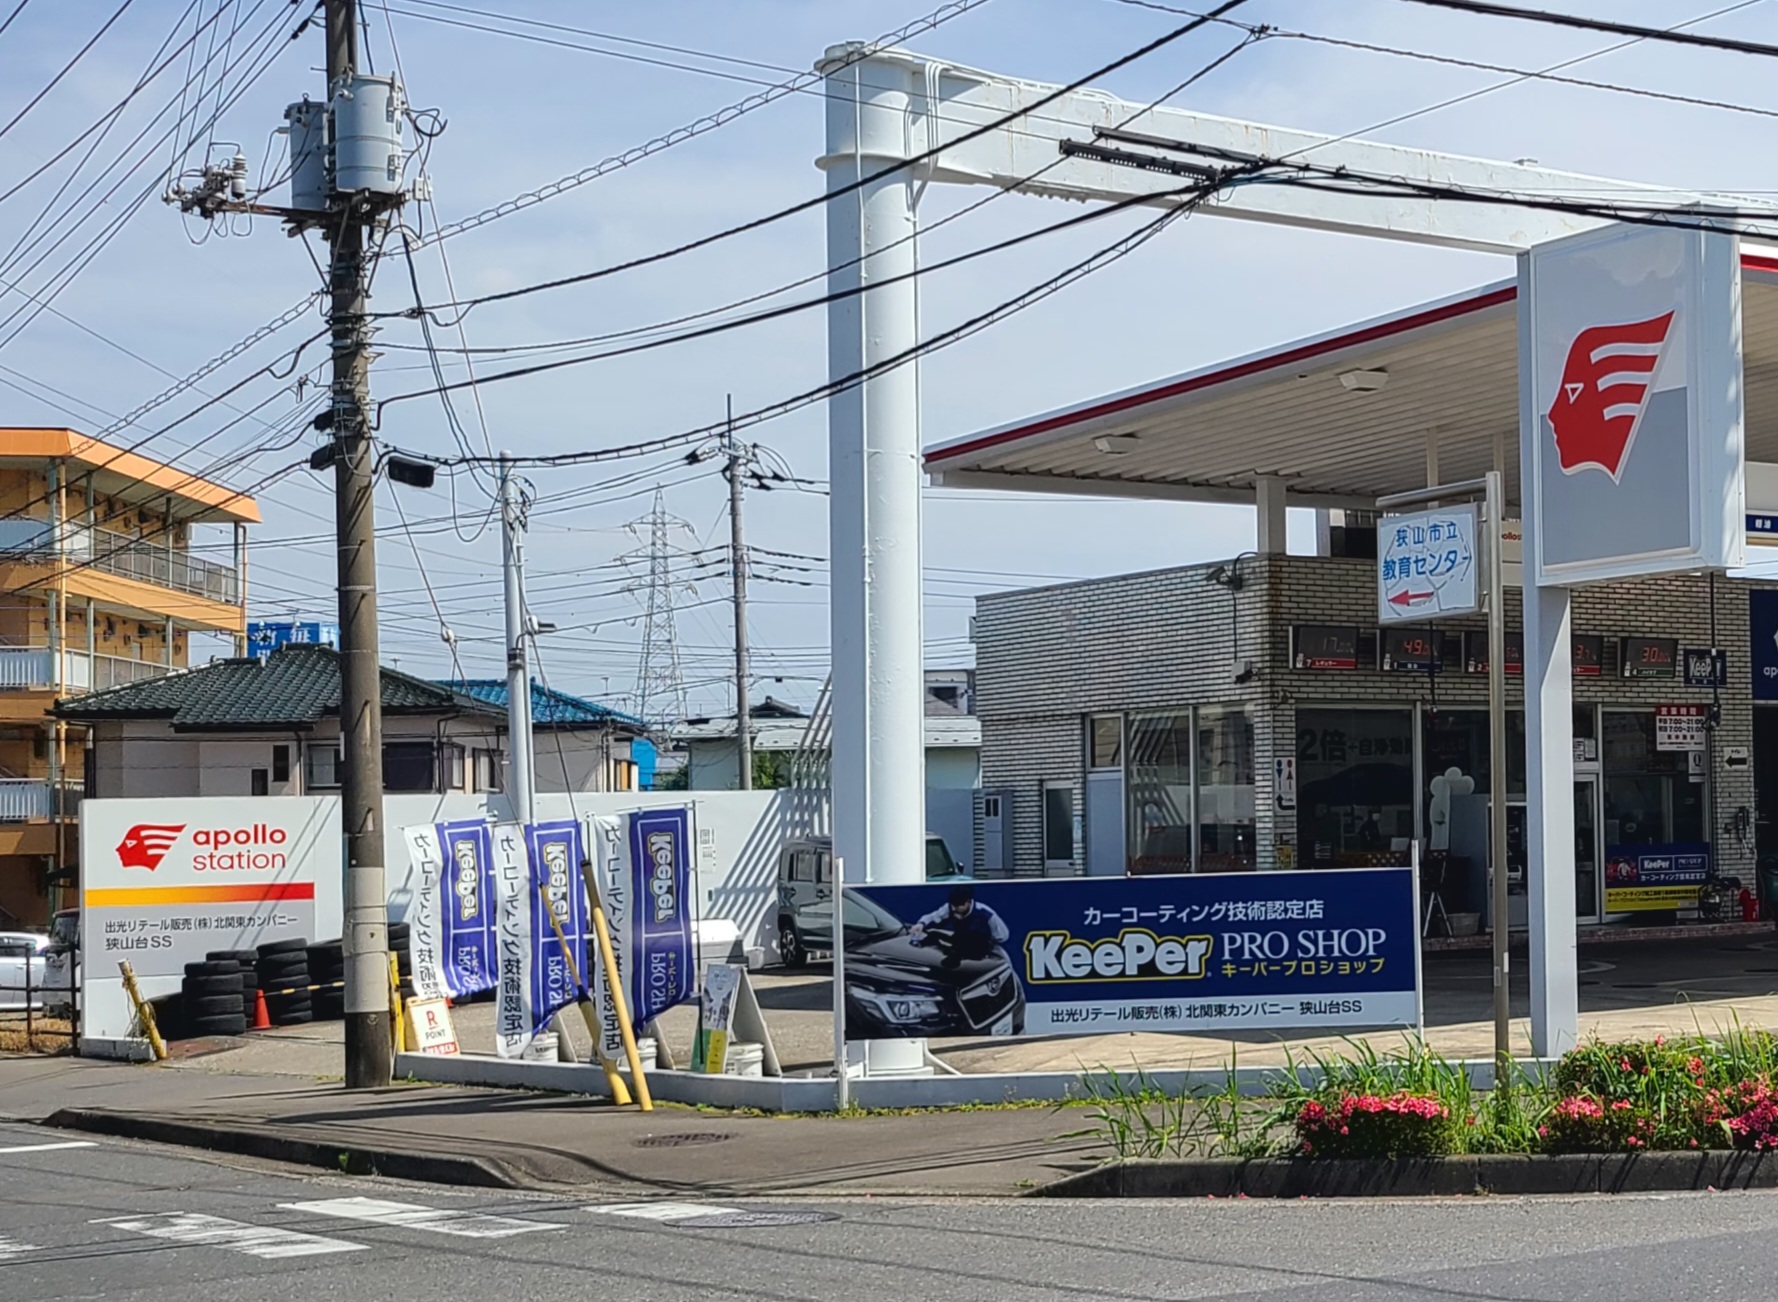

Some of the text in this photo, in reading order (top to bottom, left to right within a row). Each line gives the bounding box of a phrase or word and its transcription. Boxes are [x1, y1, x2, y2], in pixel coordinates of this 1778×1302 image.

[1396, 521, 1458, 547] 狭山市立
[1383, 549, 1472, 580] 教育センター
[1689, 655, 1721, 679] KeePr
[193, 824, 287, 850] apollo
[193, 849, 286, 870] station
[1084, 900, 1325, 926] カーコーティング技術認定店
[105, 935, 172, 951] 狭山台SS
[1221, 928, 1387, 960] PRO SHOP
[1027, 930, 1211, 981] KeePer
[1221, 958, 1385, 978] キーパープロショップ
[425, 1011, 438, 1027] R
[1185, 1001, 1295, 1018] 北関東カンパニー
[1299, 1000, 1363, 1015] 狭山台SS
[426, 1029, 446, 1041] POINT
